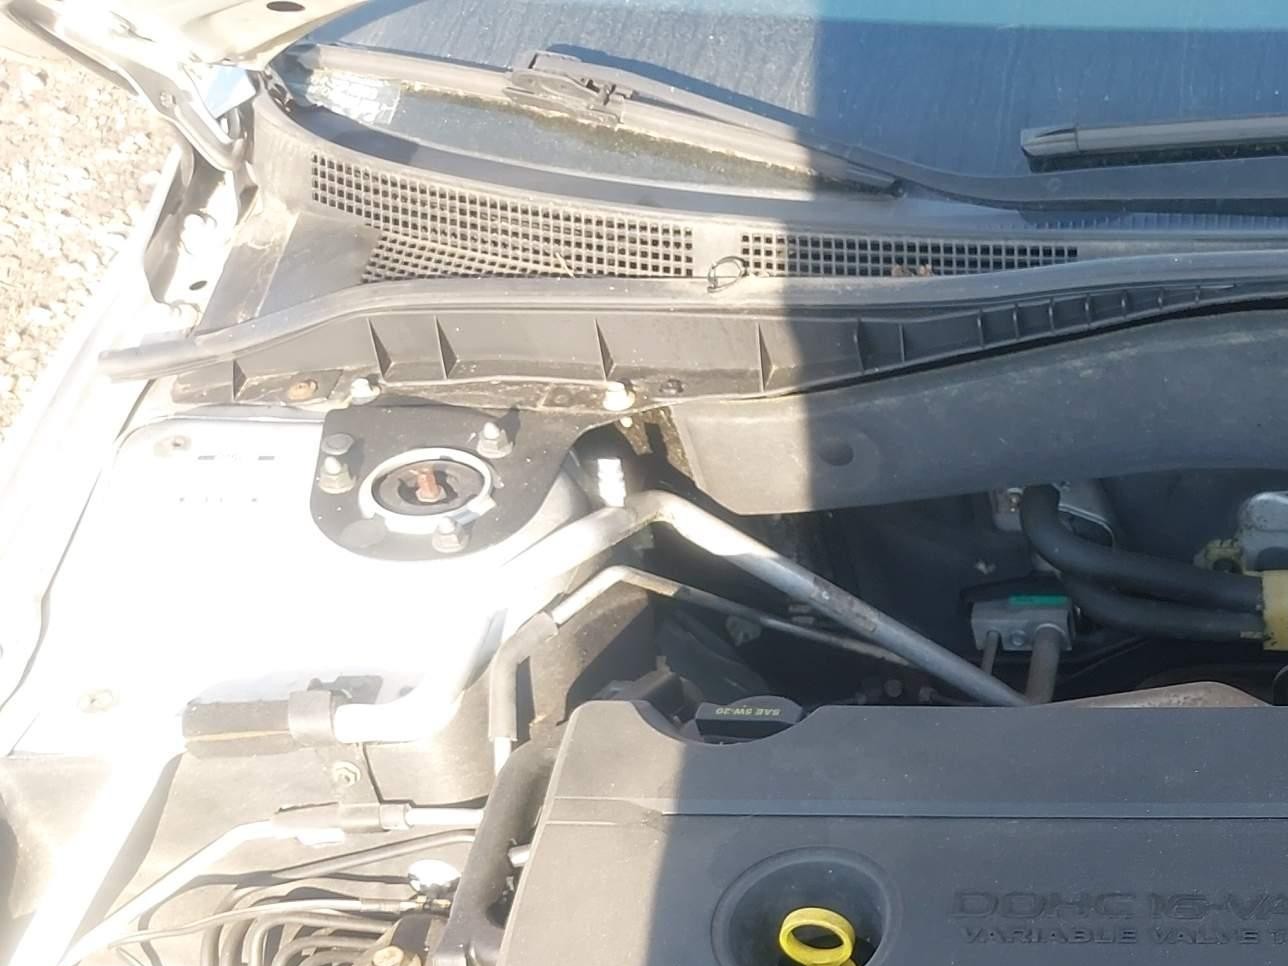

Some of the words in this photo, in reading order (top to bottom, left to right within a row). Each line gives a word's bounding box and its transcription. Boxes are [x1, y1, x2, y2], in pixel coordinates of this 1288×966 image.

[755, 708, 780, 716] SAE
[951, 891, 1137, 920] DOHC
[959, 925, 1138, 944] VARIABLE
[1151, 925, 1260, 944] VALVE
